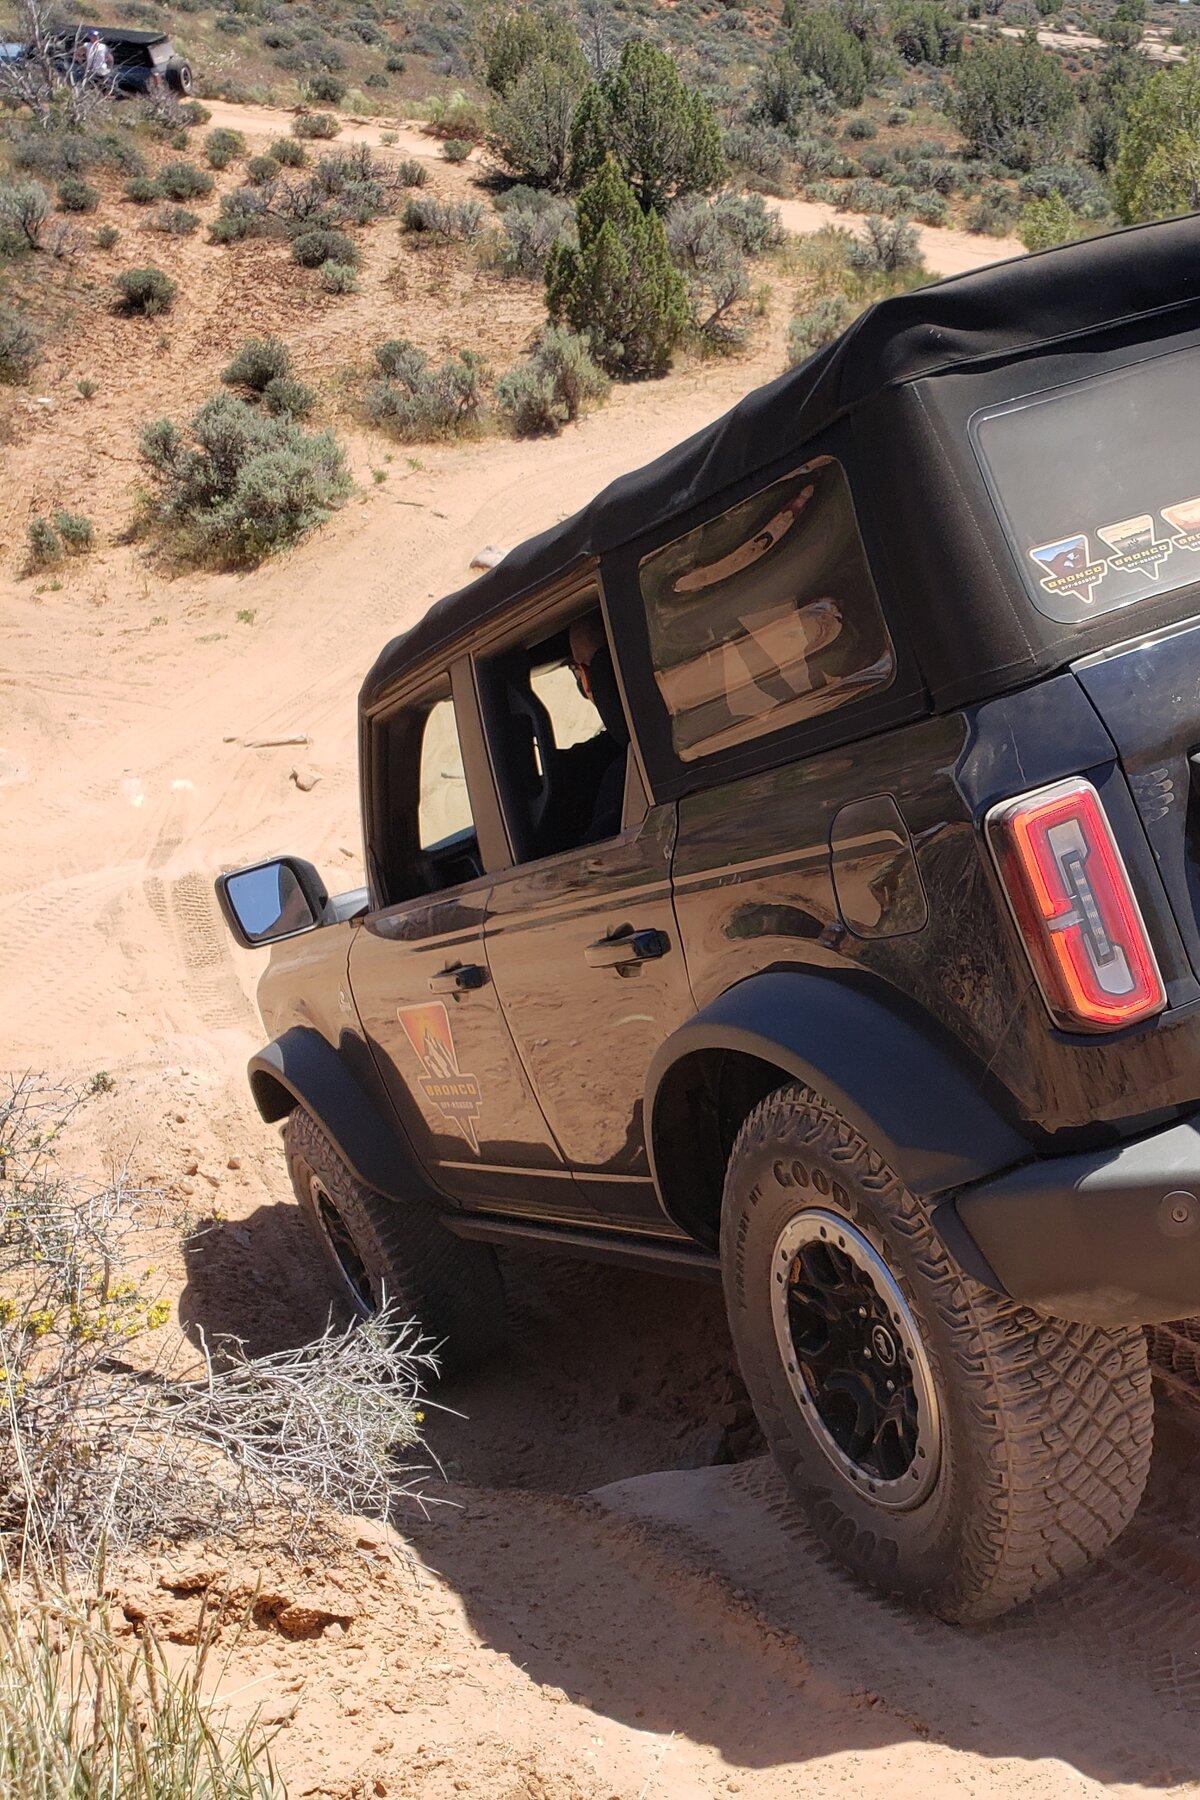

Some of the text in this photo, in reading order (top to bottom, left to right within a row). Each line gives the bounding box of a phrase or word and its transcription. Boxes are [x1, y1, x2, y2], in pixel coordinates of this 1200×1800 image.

[1114, 544, 1168, 566] BRONCO
[1048, 566, 1102, 588] BRONCO
[425, 1083, 477, 1097] BRONCO
